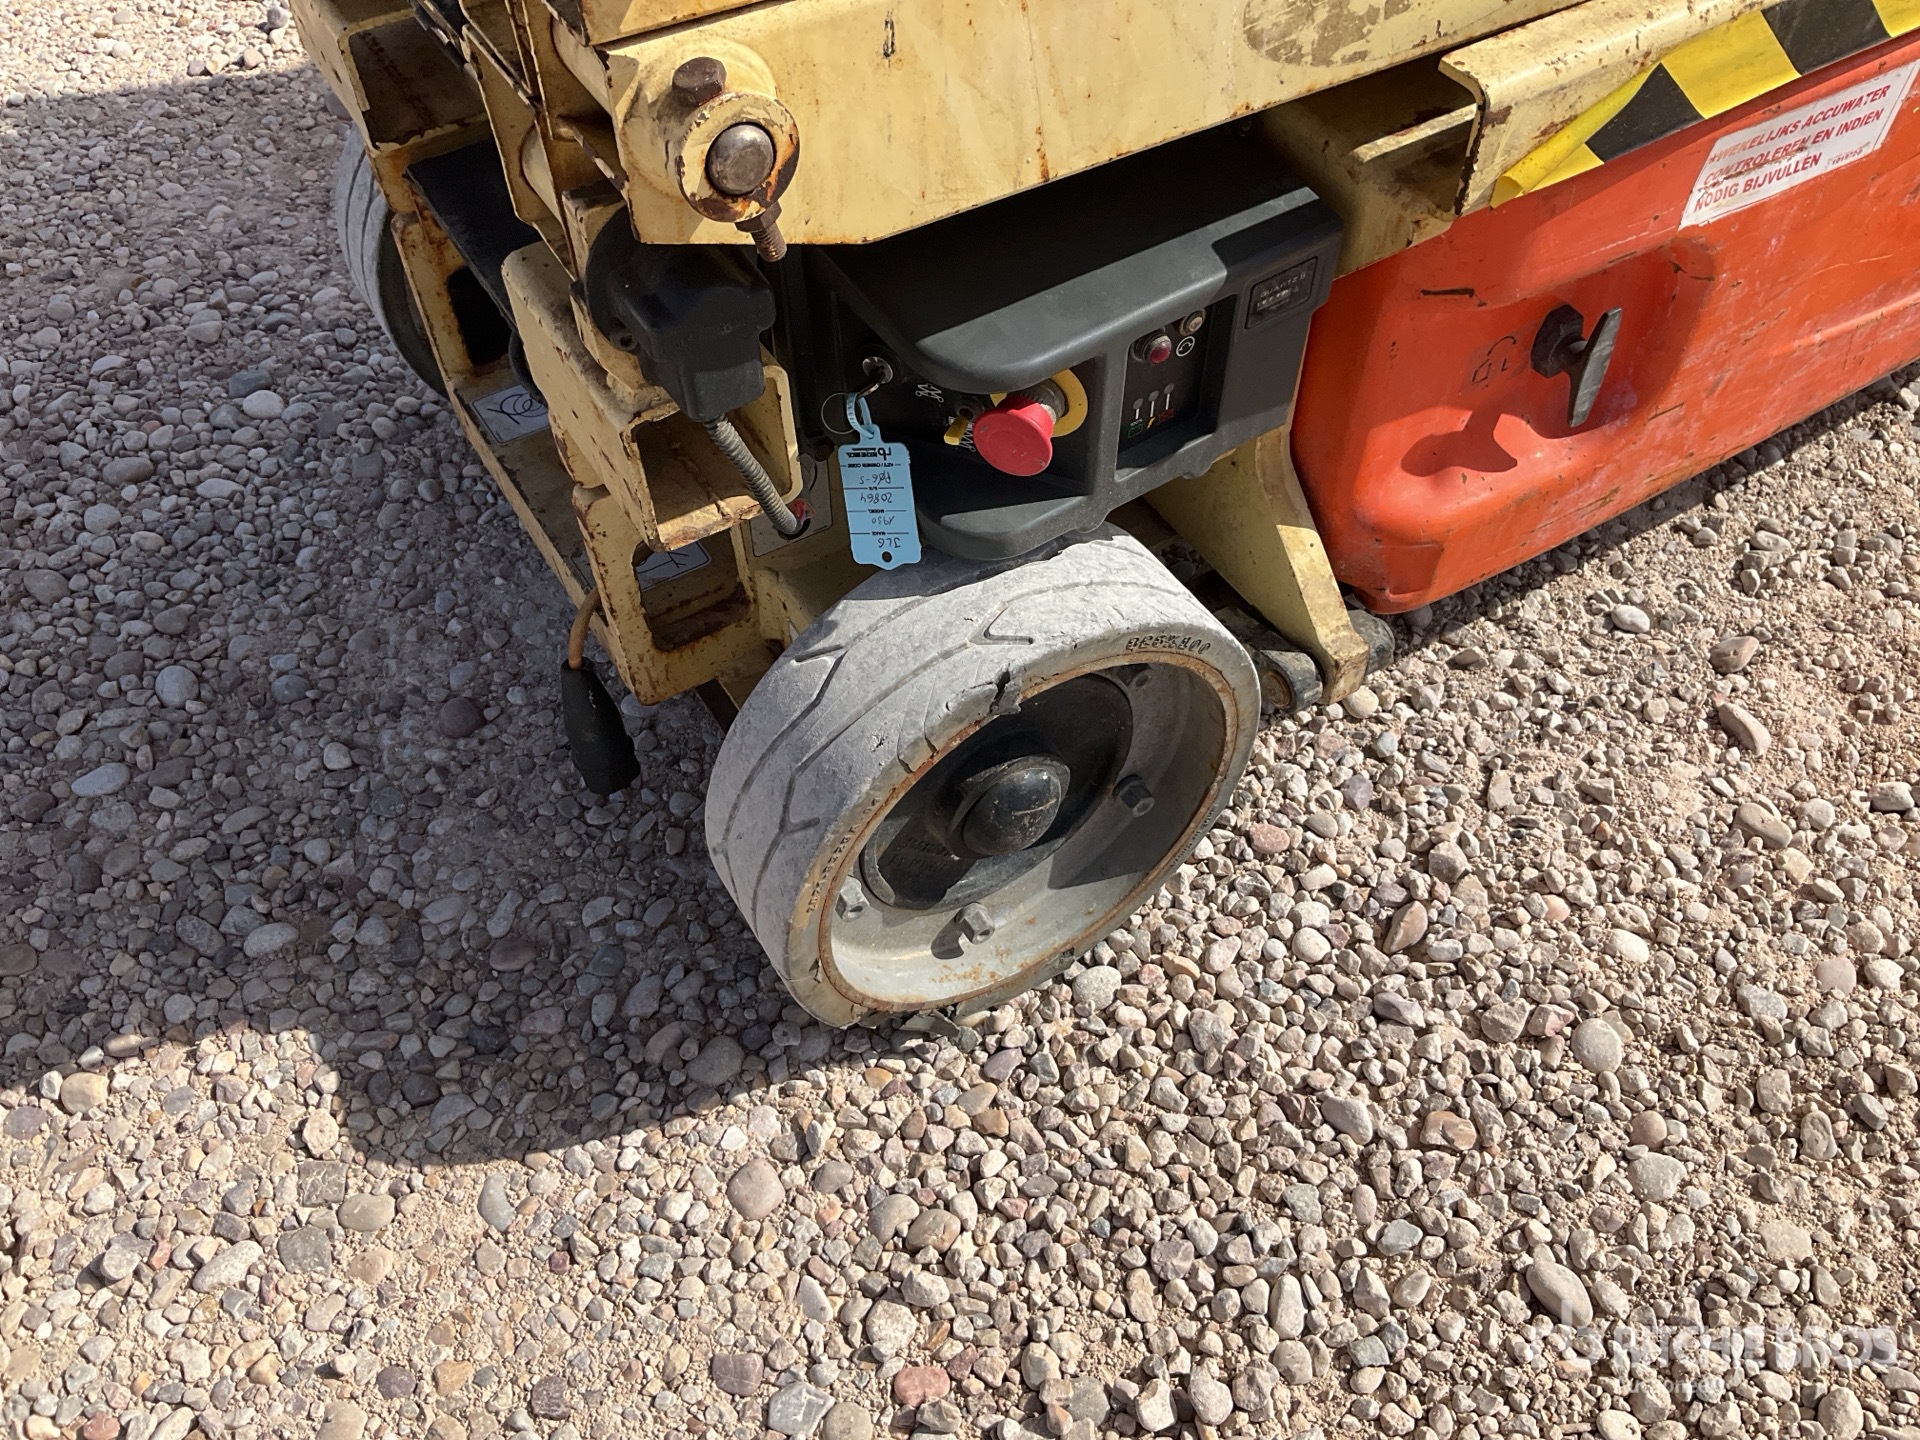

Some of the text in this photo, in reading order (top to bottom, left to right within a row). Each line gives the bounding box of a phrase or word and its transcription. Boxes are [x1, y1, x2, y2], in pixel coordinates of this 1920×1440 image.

[1801, 85, 1891, 129] ACCUWATER
[1813, 127, 1834, 144] EN
[1835, 108, 1884, 137] INDIEN
[1694, 152, 1822, 213] NODIG BIJVULLEN
